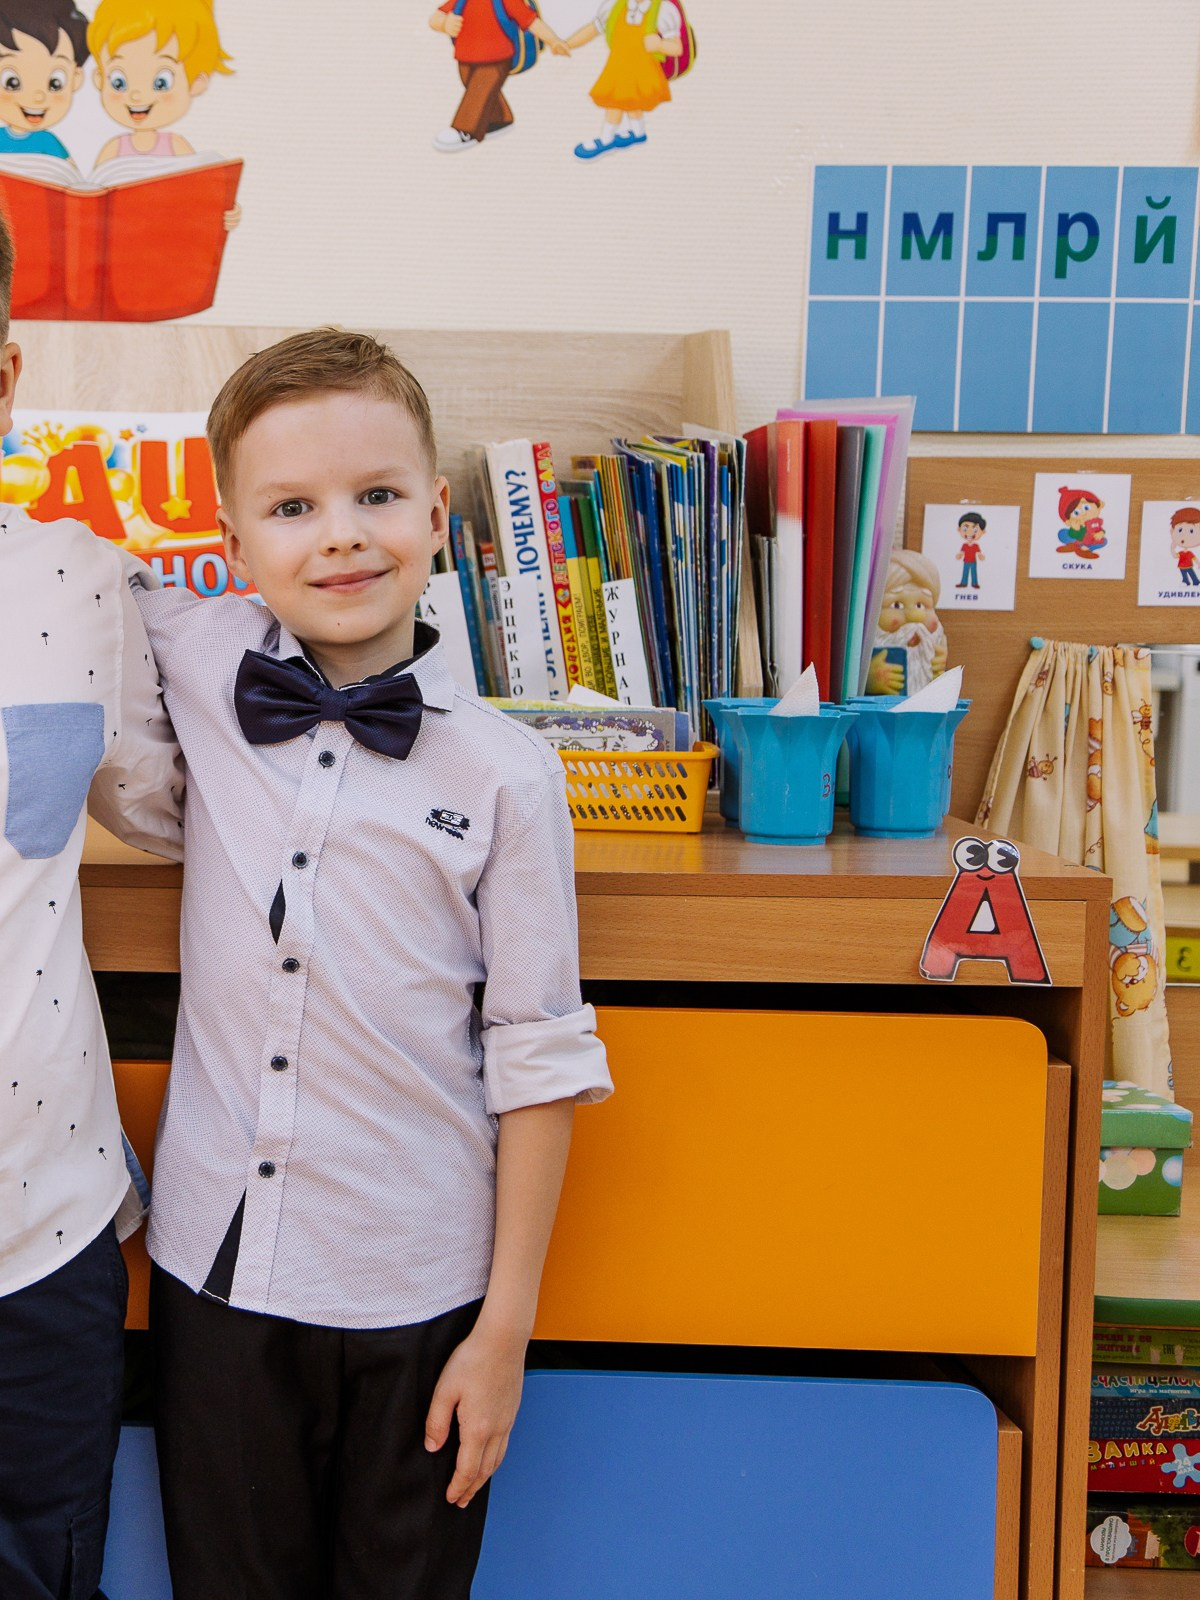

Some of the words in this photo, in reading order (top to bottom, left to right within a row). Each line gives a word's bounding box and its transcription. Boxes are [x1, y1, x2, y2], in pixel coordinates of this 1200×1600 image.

[1133, 196, 1177, 264] й
[544, 499, 569, 585] ДЕТСКОГО
[955, 593, 978, 601] ГНЕВ
